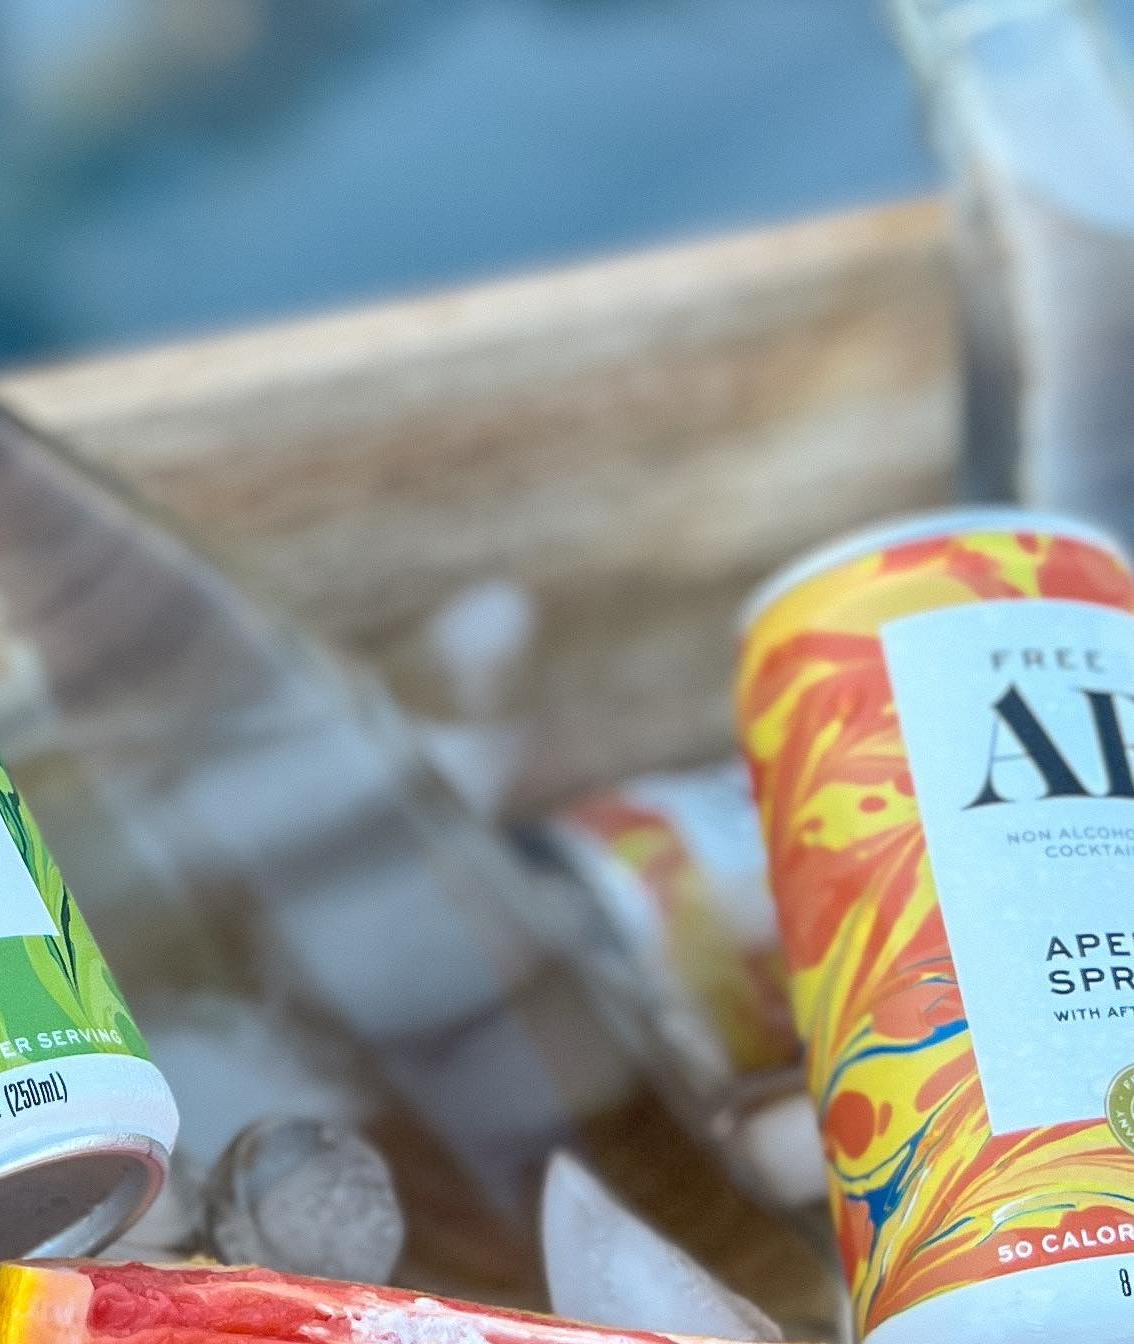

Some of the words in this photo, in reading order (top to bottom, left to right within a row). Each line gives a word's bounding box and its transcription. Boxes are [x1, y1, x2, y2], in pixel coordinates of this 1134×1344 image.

[989, 647, 1104, 674] FREE
[1005, 829, 1051, 846] NON
[1046, 931, 1134, 962] APE
[1053, 1006, 1101, 1023] WITH
[37, 1026, 123, 1050] SERVING
[3, 1070, 69, 1118] (250mL)
[997, 1240, 1034, 1264] 50
